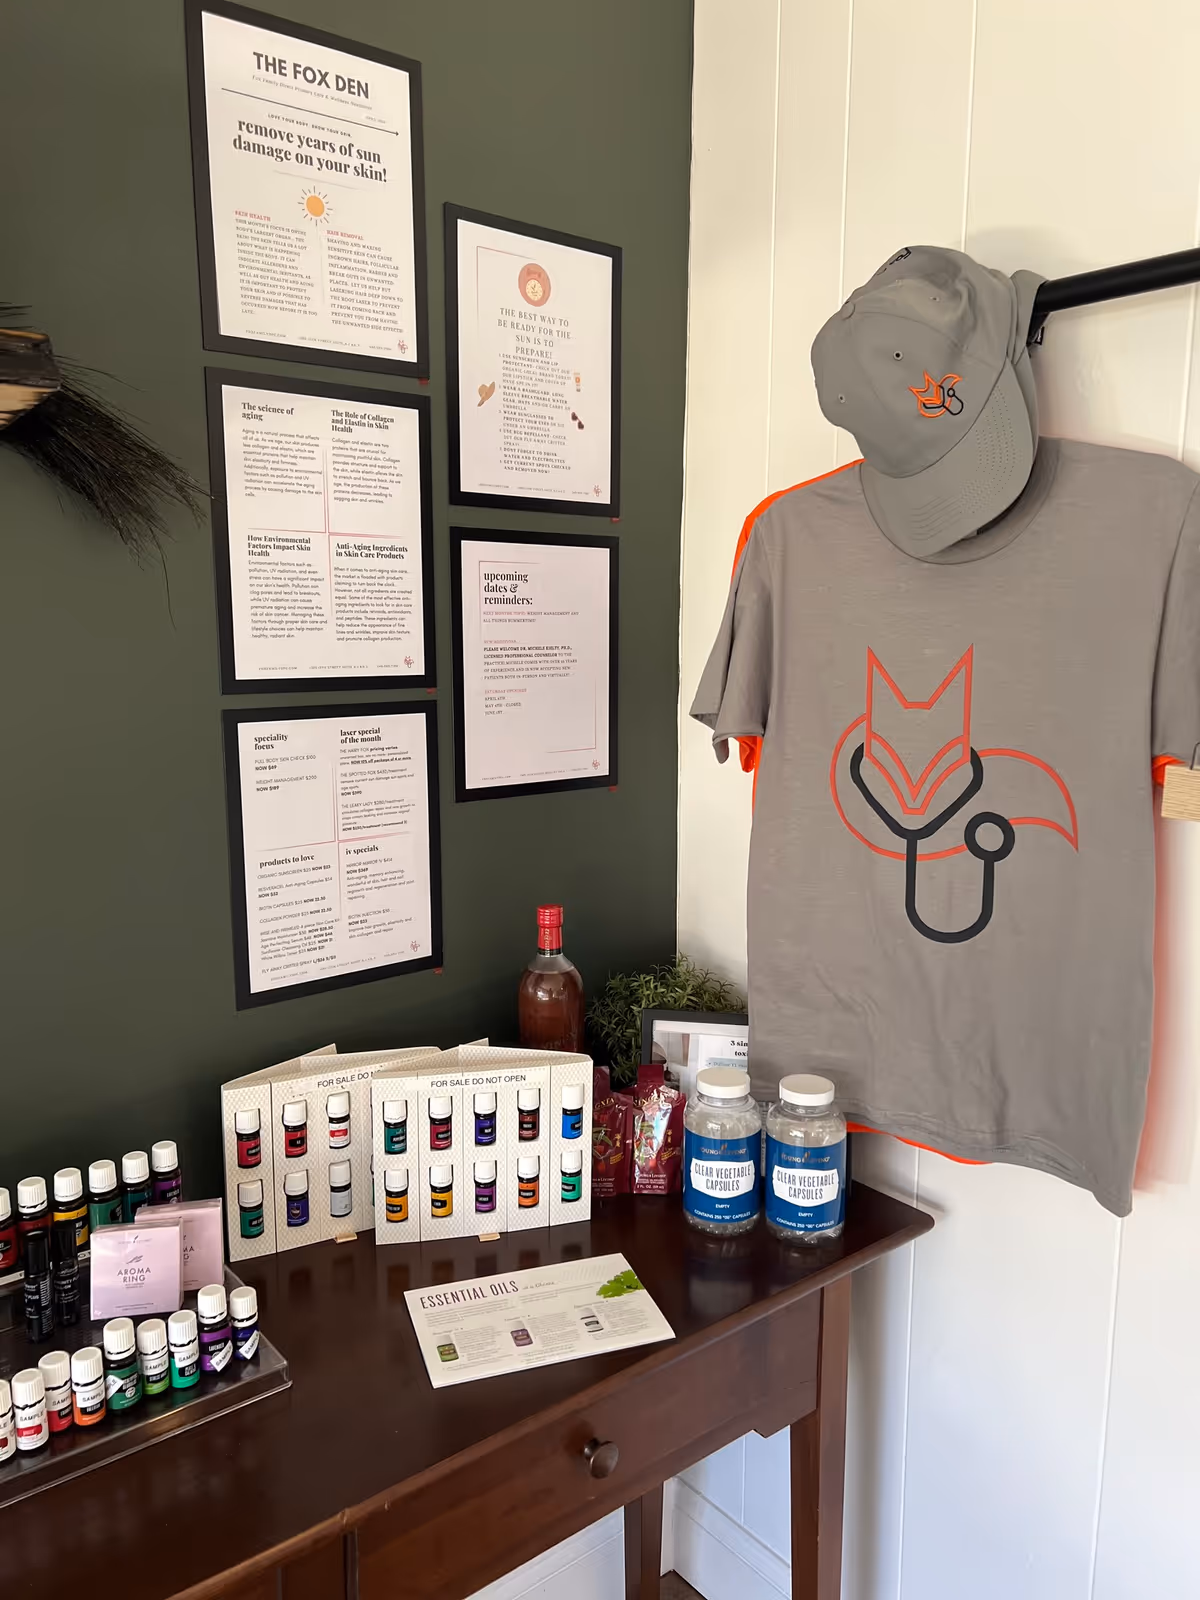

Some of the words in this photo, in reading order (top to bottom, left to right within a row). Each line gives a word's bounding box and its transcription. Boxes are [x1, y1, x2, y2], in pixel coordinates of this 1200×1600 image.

[253, 52, 287, 76] THE
[293, 63, 331, 89] FOX
[336, 75, 369, 99] DEN
[238, 120, 293, 144] remove
[297, 133, 335, 154] years
[339, 143, 354, 157] of
[356, 149, 381, 163] sun
[233, 135, 291, 162] damage
[295, 152, 313, 166] on
[318, 157, 351, 175] your
[353, 163, 387, 183] skin!
[500, 308, 516, 317] THE
[519, 311, 537, 322] BEST
[540, 315, 557, 325] WAY
[559, 319, 569, 327] TO
[498, 319, 507, 328] BE
[511, 321, 536, 333] READY
[539, 327, 553, 336] FOR
[556, 330, 571, 339] THE
[516, 335, 531, 344] SUN
[544, 339, 554, 347] TO
[516, 346, 552, 359] PREPARE!
[242, 402, 256, 411] The
[258, 405, 285, 414] science
[242, 412, 263, 421] aging
[345, 411, 359, 419] Role
[368, 414, 394, 424] Collagen
[332, 425, 353, 433] Health
[345, 419, 366, 427] Elastin
[375, 422, 389, 430] Skin
[264, 536, 311, 544] Environmental
[248, 542, 272, 550] Factors
[273, 543, 296, 551] Impact
[336, 543, 371, 552] Anti-Aging
[373, 544, 408, 553] Ingredients
[344, 550, 359, 558] Skin
[377, 552, 404, 560] Products
[484, 571, 529, 583] upcoming
[484, 583, 508, 593] dates
[510, 584, 519, 593] &
[484, 595, 533, 605] reminders:
[359, 727, 381, 736] special
[254, 733, 288, 743] speciality
[361, 735, 382, 743] month
[255, 743, 274, 751] focus
[353, 845, 379, 855] specials
[260, 857, 291, 869] products
[301, 854, 315, 862] love
[317, 1078, 334, 1089] FOR
[336, 1075, 356, 1085] SALE
[357, 1072, 369, 1080] DO
[430, 1080, 448, 1088] FOR
[450, 1078, 470, 1086] SALE
[486, 1076, 502, 1084] NOT
[504, 1075, 526, 1083] OPEN
[695, 1163, 714, 1178] CLEAR
[716, 1164, 751, 1180] VEGETABLE
[777, 1170, 796, 1185] CLEAR
[800, 1172, 835, 1187] VEGETABLE
[706, 1179, 740, 1192] CAPSULES
[788, 1186, 823, 1200] CAPSULES
[694, 1209, 714, 1219] CONTAINS
[733, 1211, 751, 1219] CAPSULES
[776, 1217, 796, 1228] CONTAINS
[816, 1220, 834, 1228] CAPSULES
[117, 1267, 152, 1276] AROMA
[123, 1275, 146, 1283] RING
[420, 1286, 488, 1309] ESSENTIAL
[489, 1280, 519, 1298] OILS
[245, 1333, 259, 1355] SAMPLE
[179, 1350, 198, 1362] SAMPLE
[216, 1345, 232, 1366] SAMPLE
[145, 1361, 167, 1371] SAMPLE
[82, 1391, 104, 1402] SAMPLE
[20, 1410, 44, 1422] SAMPLE
